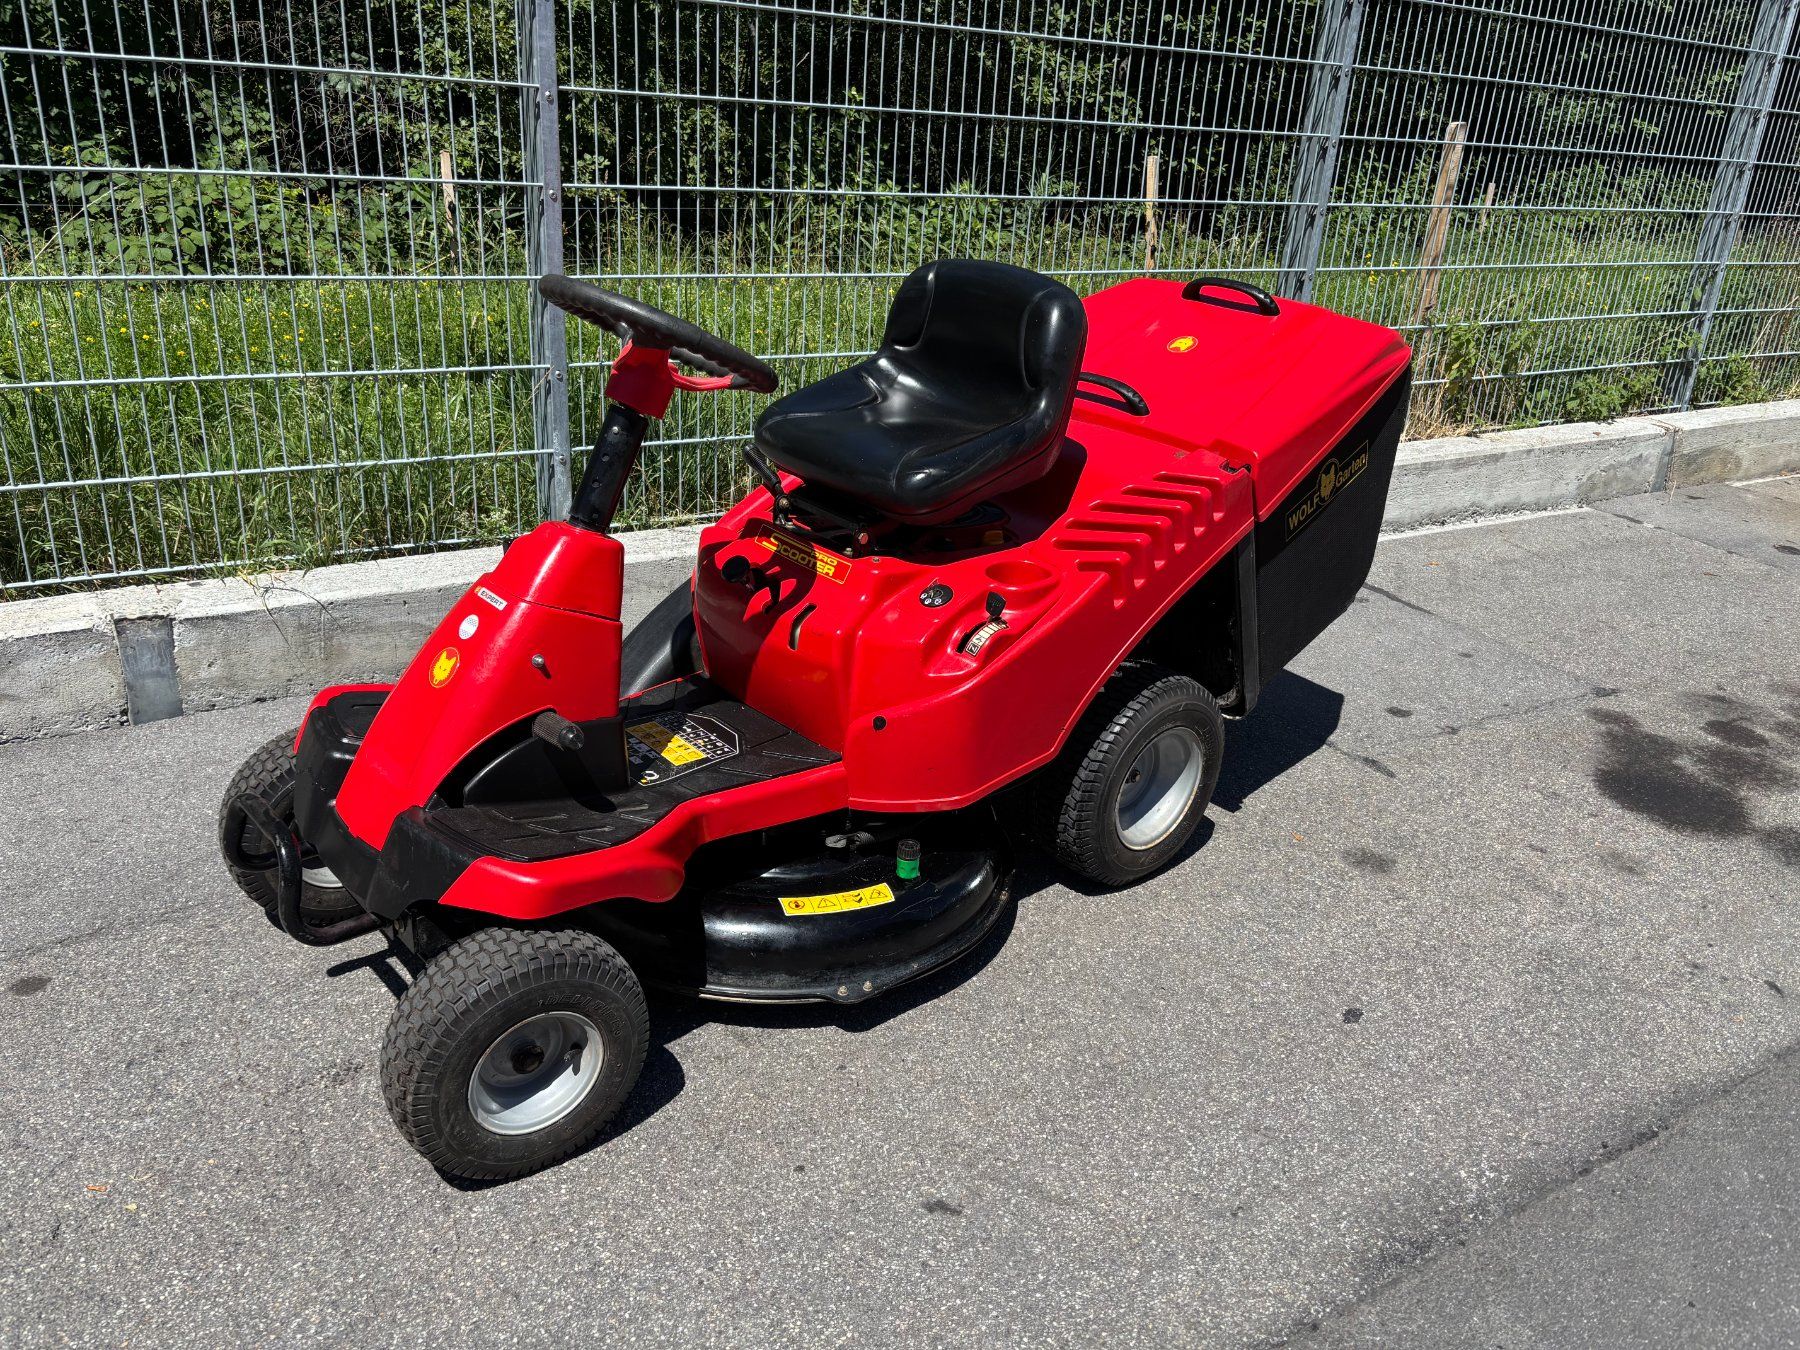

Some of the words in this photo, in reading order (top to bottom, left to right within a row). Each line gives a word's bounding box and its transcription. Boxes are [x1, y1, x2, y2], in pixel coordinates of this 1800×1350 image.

[1288, 492, 1320, 531] WOLF
[1335, 452, 1366, 488] Garten
[760, 531, 836, 577] SCOOTER
[810, 549, 839, 567] PRO
[480, 589, 504, 607] EXPERT
